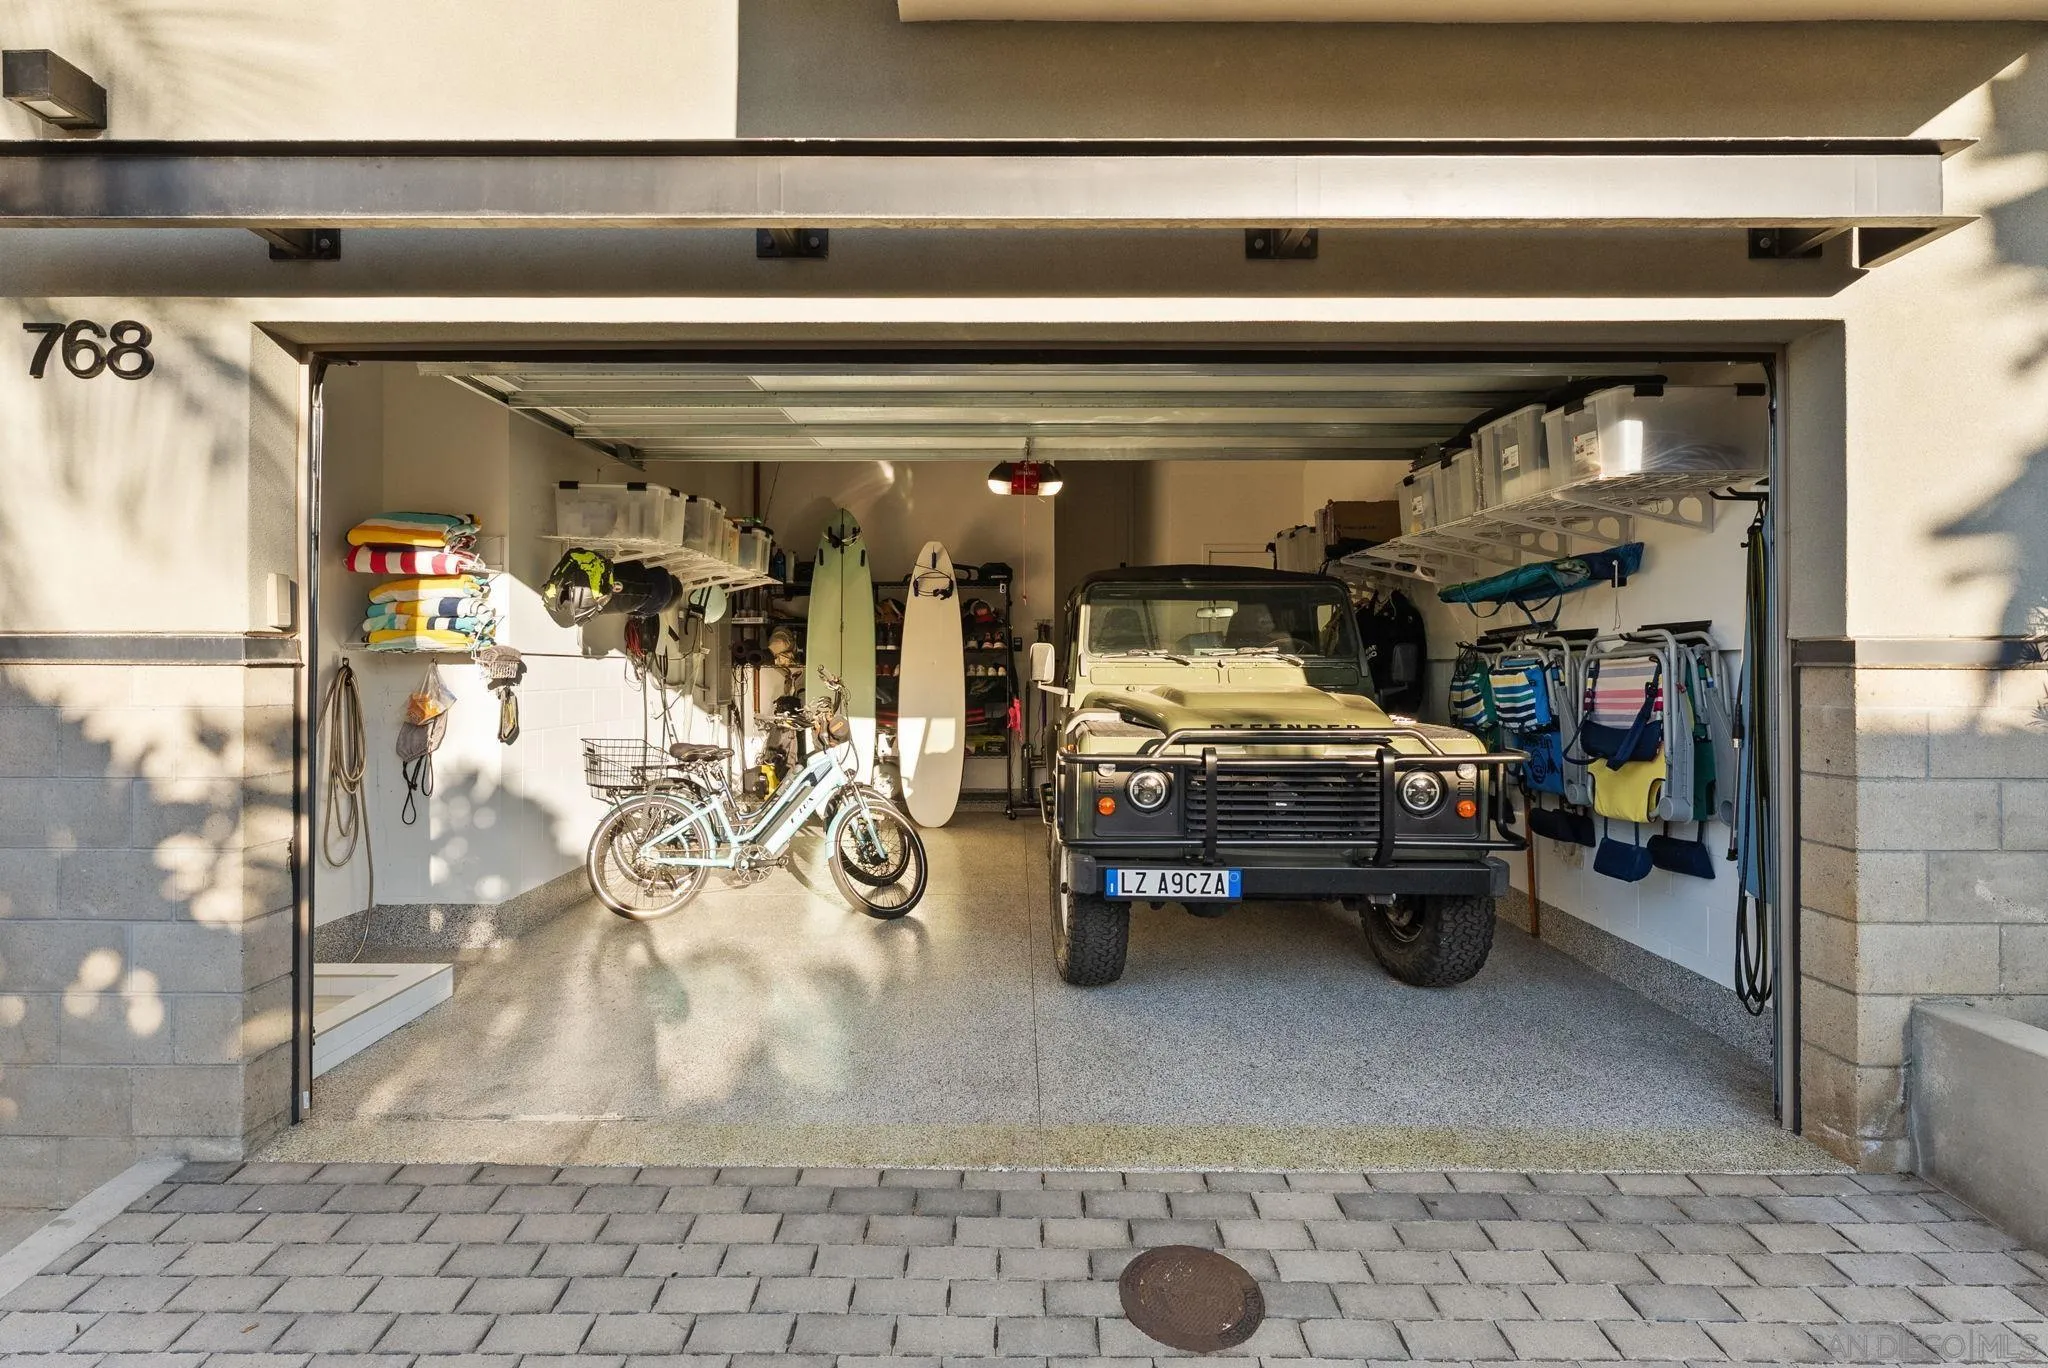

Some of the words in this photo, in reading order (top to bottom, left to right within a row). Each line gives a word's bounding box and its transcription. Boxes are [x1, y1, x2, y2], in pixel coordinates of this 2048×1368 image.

[23, 319, 154, 380] 768
[1121, 871, 1147, 894] LZ
[1158, 872, 1225, 894] A9CZA
